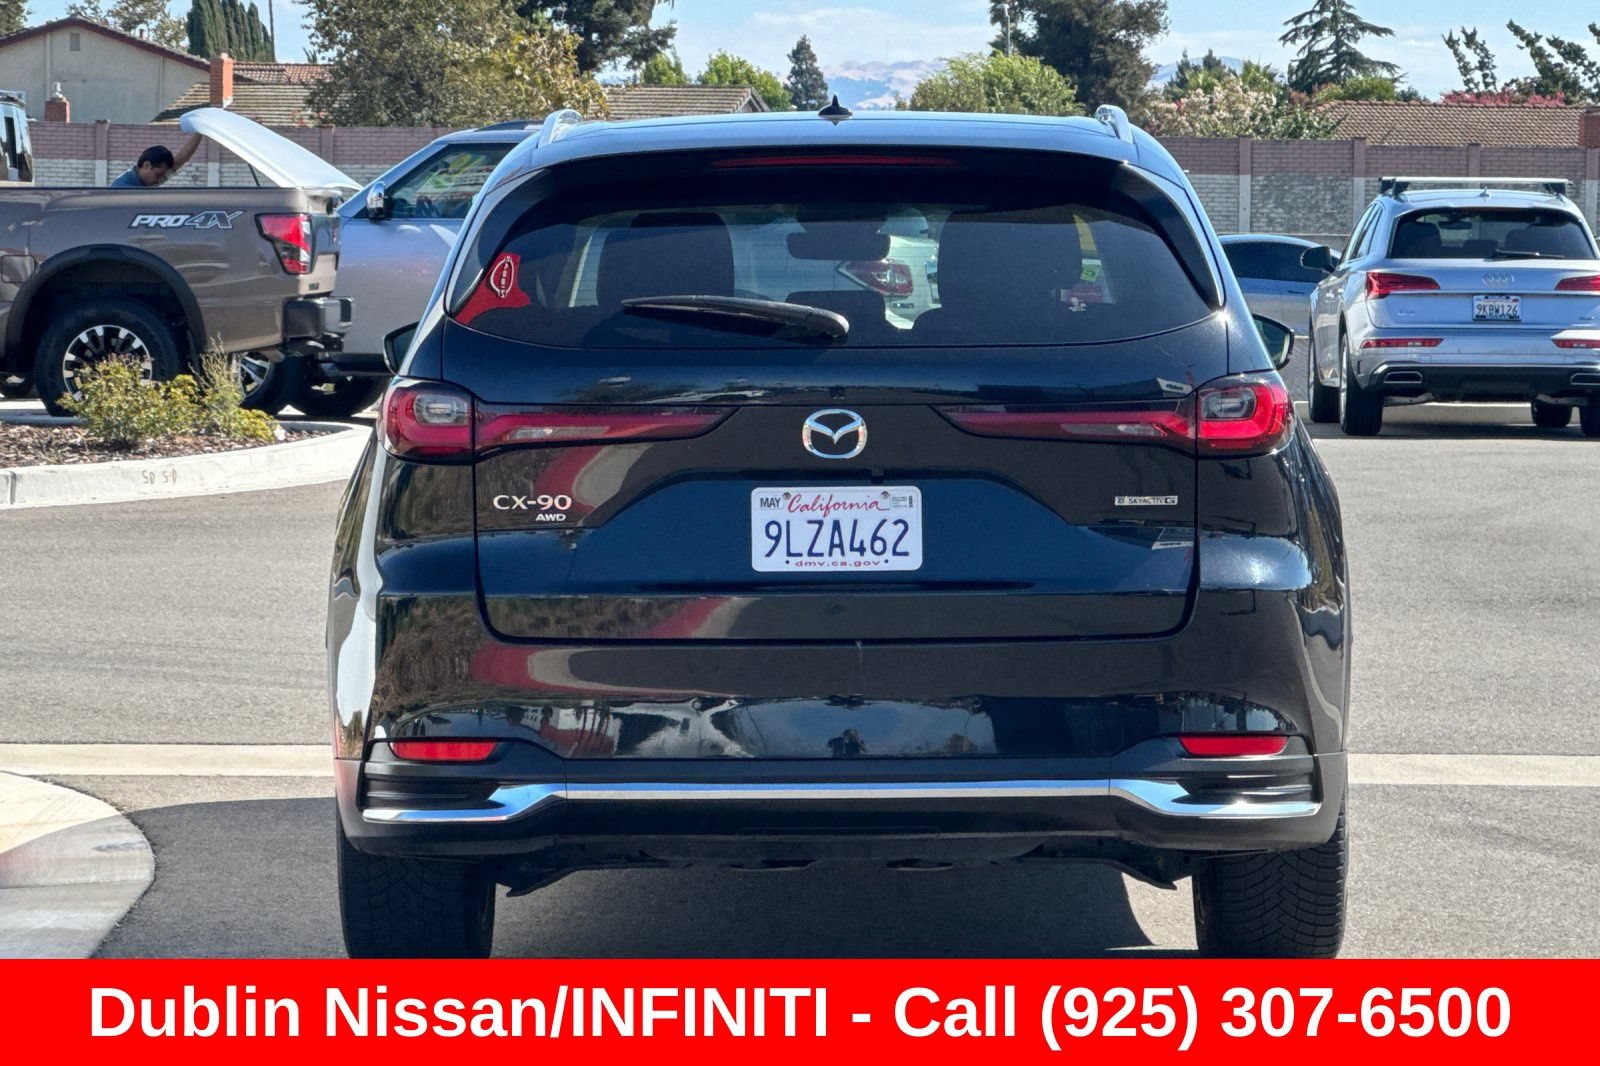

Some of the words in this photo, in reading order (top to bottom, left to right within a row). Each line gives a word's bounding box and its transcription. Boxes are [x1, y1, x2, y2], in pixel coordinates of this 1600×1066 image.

[492, 494, 572, 511] CX-90
[759, 497, 782, 508] MAY
[787, 493, 890, 518] California
[535, 513, 567, 522] AWD
[764, 518, 910, 558] 9LZA462
[795, 559, 880, 567] dmv.ca.gov
